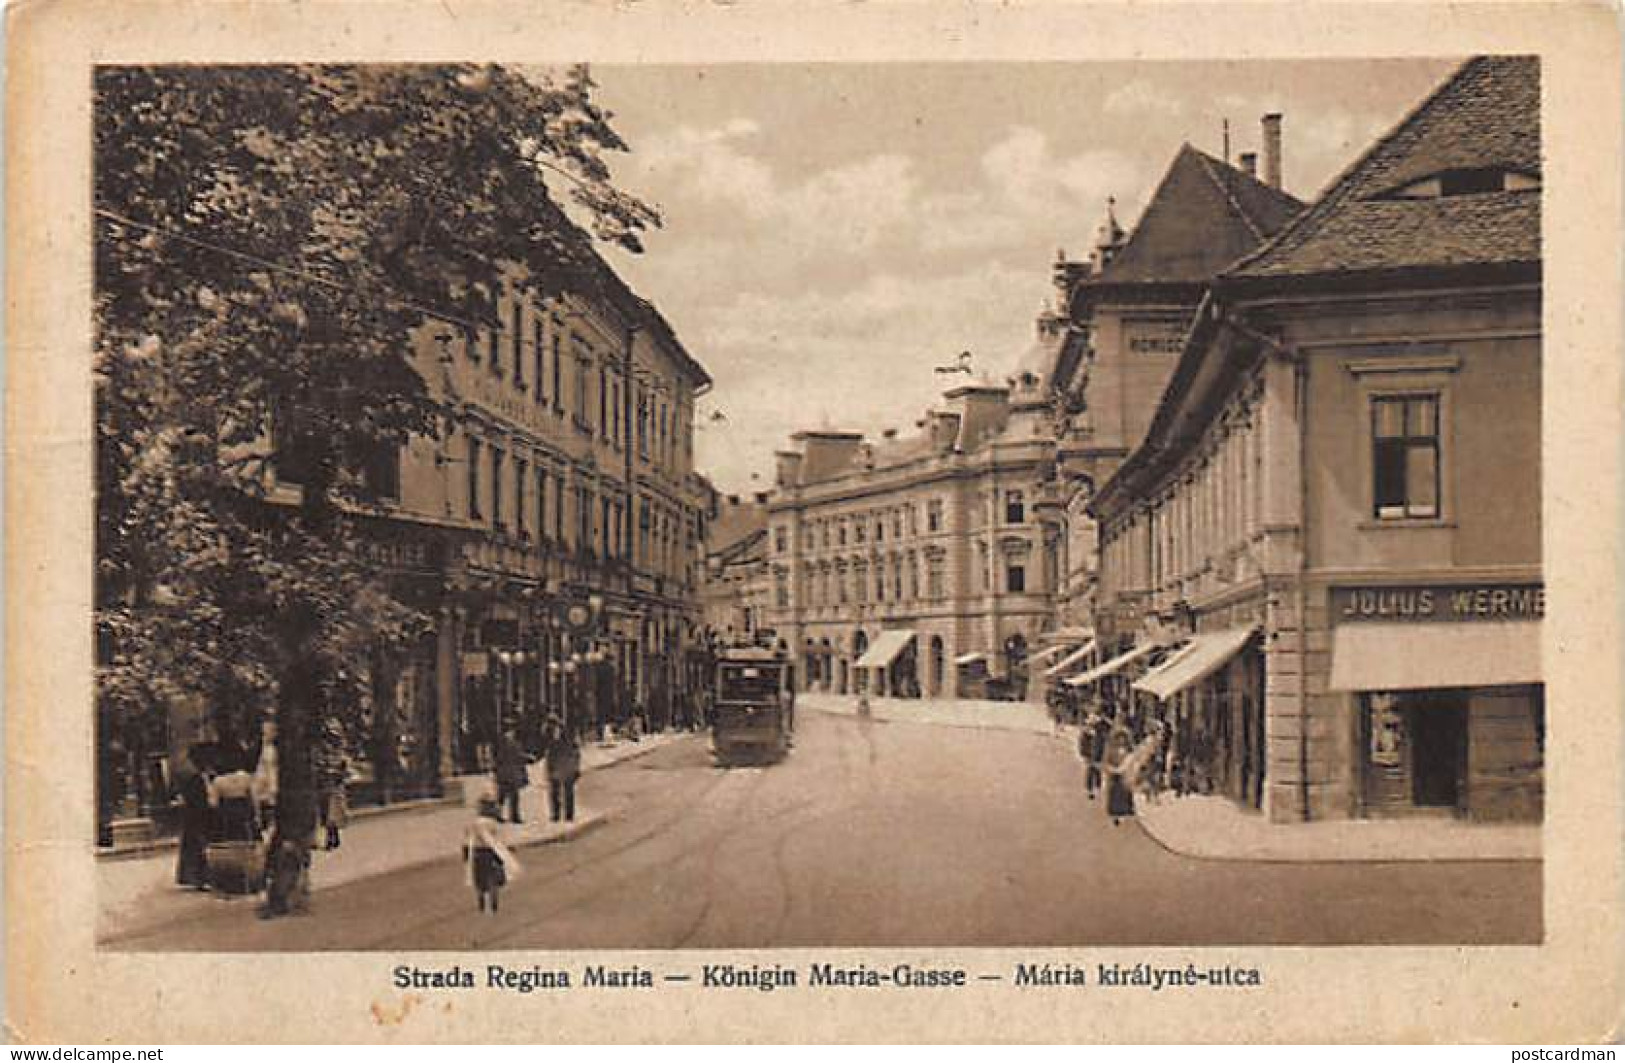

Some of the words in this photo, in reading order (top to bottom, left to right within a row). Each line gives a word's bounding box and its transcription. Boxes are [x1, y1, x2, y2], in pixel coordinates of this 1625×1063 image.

[1343, 590, 1434, 616] JULIUS
[393, 966, 475, 988] Strada
[487, 965, 570, 993] Regina
[583, 965, 653, 988] Maria
[702, 963, 797, 992] Königin
[809, 963, 966, 987] Maria-Gasse
[1015, 963, 1085, 986] Mária
